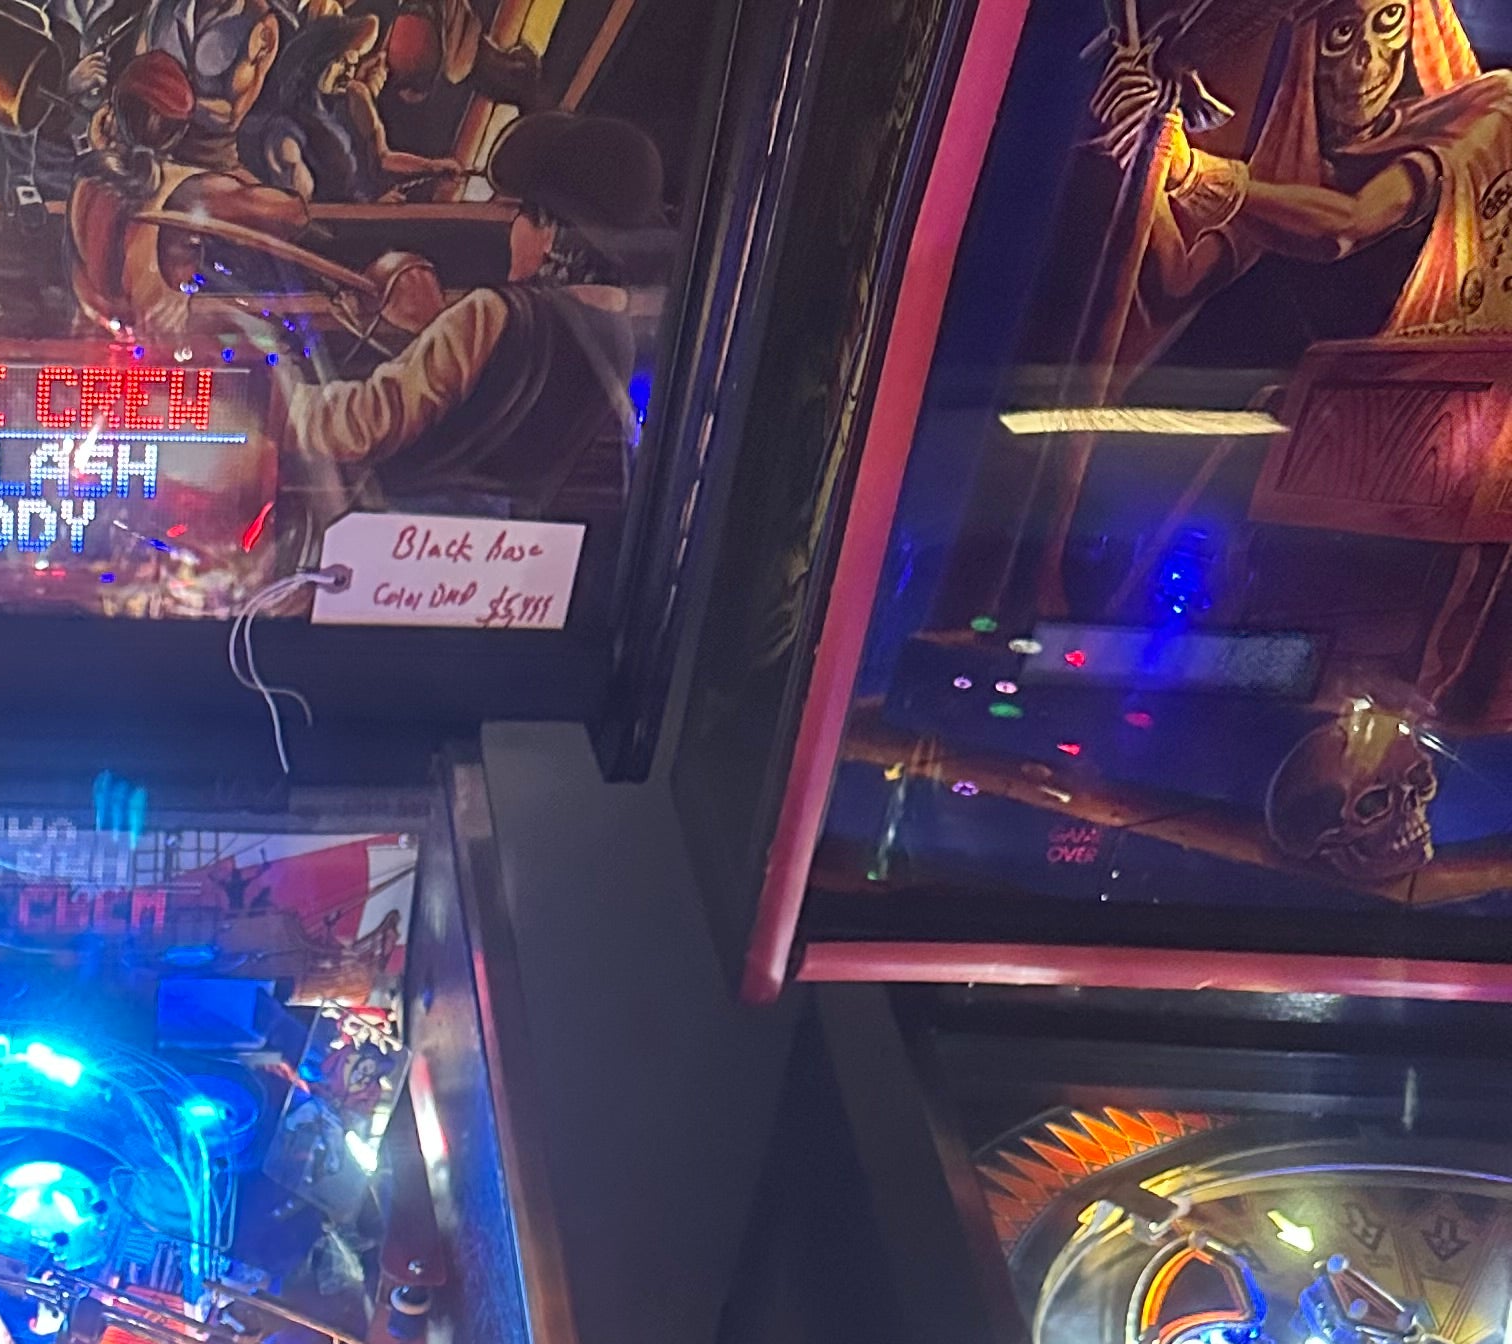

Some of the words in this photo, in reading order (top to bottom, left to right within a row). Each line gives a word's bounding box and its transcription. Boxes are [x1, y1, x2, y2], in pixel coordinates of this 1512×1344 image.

[35, 365, 213, 432] CREW
[392, 525, 472, 562] Black
[1047, 846, 1097, 863] OVER
